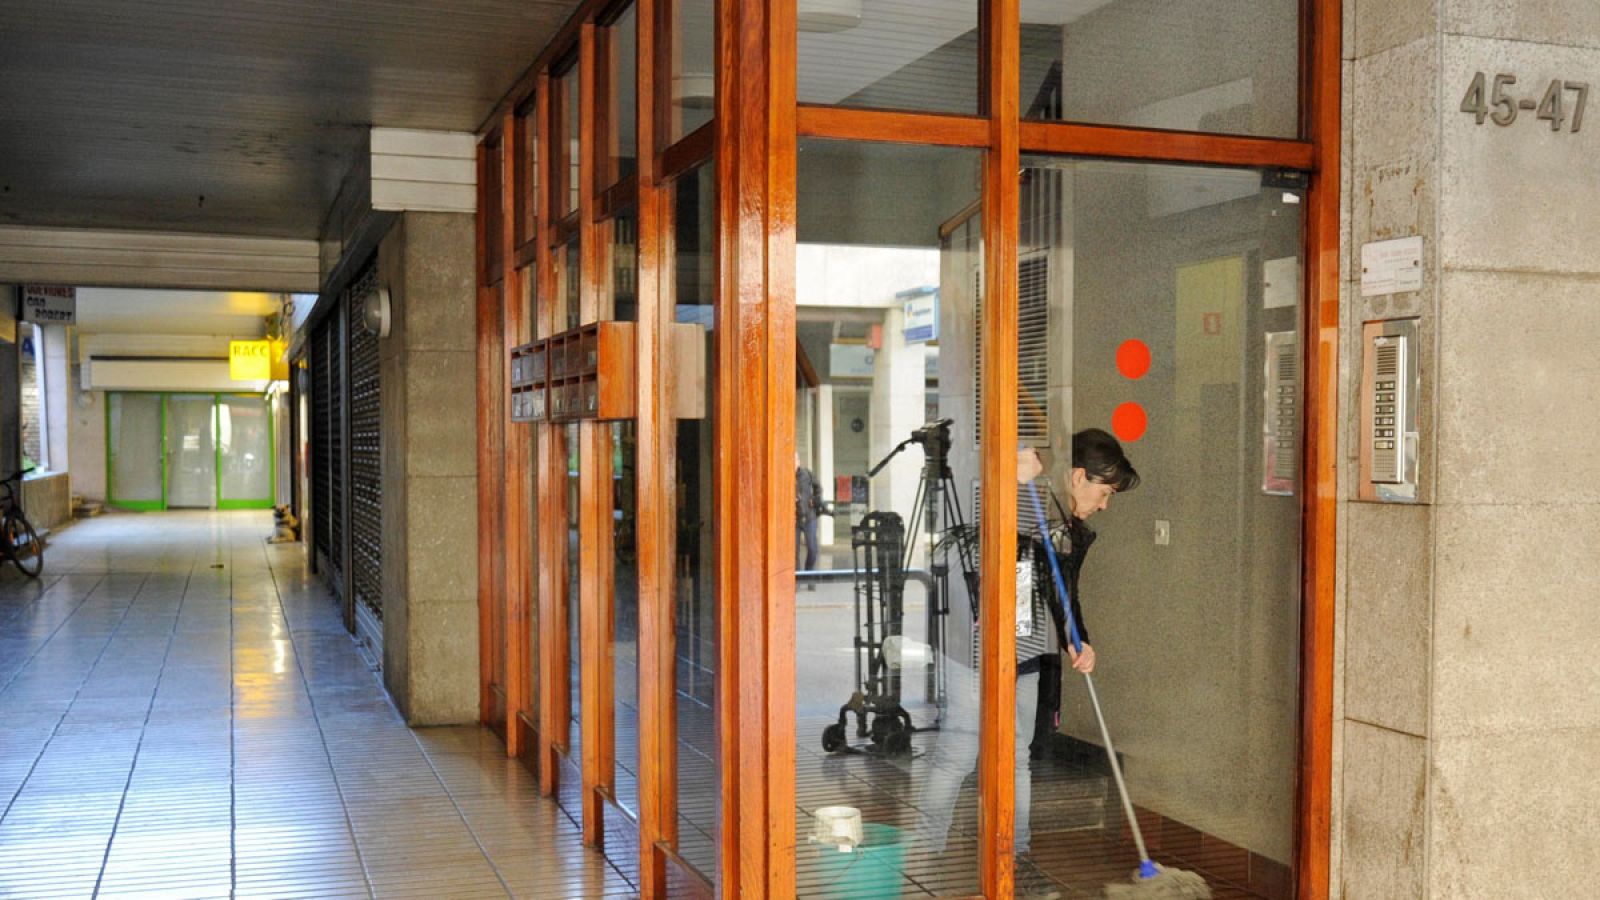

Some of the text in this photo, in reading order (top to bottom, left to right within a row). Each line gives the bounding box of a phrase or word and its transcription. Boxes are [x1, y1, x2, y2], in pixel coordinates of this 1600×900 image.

[1460, 72, 1589, 132] 45-47
[35, 308, 72, 320] ROBERT
[234, 345, 268, 357] RACC
